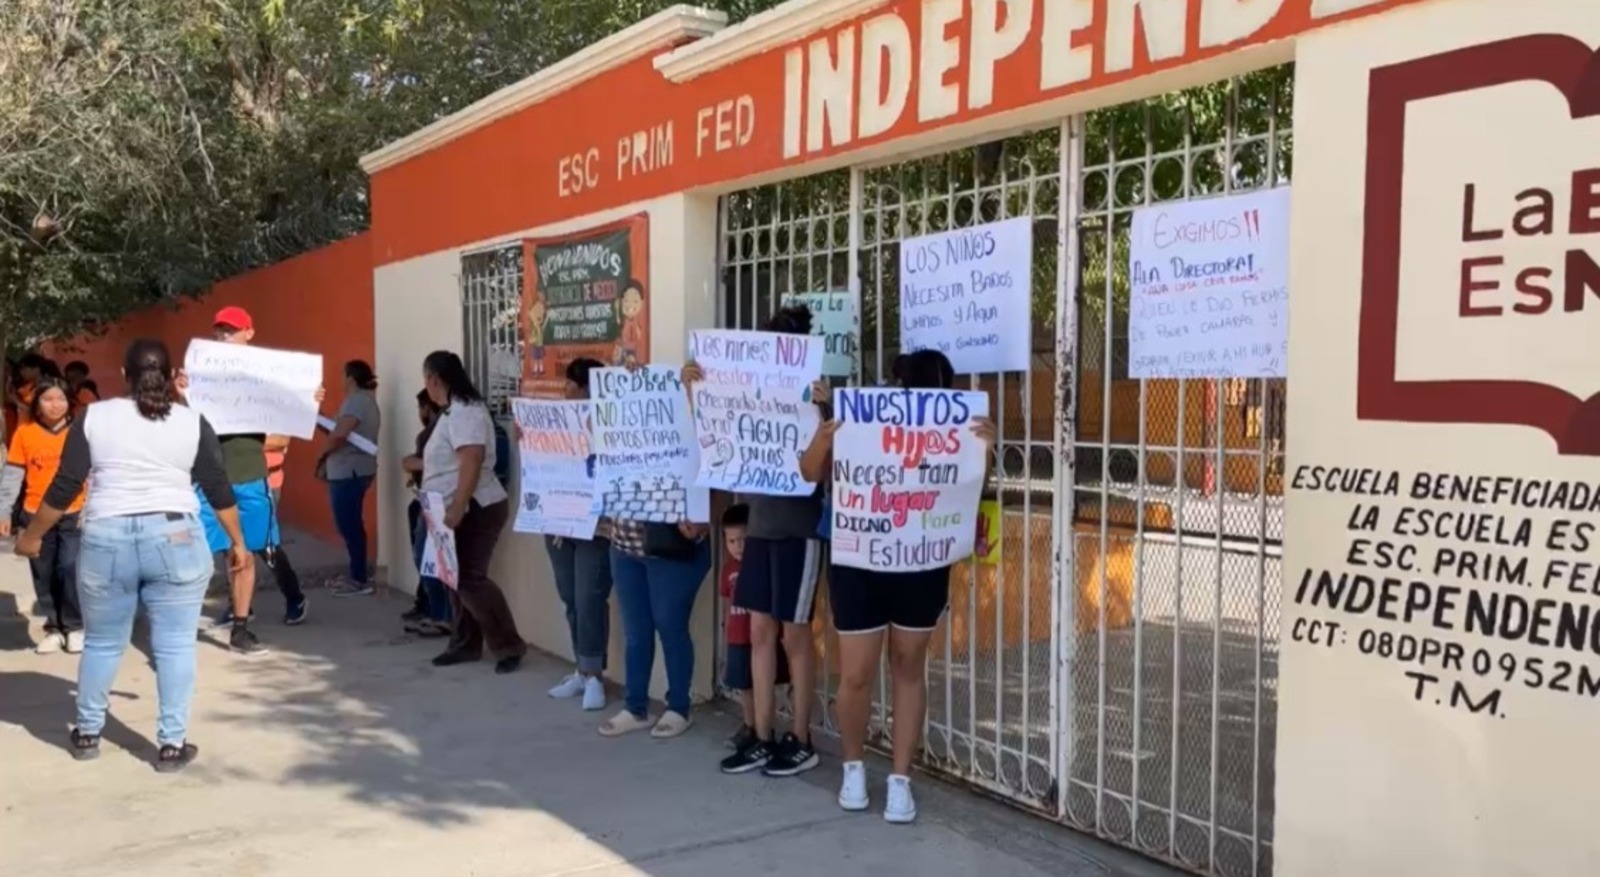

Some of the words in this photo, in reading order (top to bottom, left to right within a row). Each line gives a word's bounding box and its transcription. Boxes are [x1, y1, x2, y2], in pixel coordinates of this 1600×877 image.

[783, 0, 1388, 158] INDEPEN
[559, 147, 599, 197] ESC
[617, 120, 673, 181] PRIM
[697, 94, 755, 157] FED
[905, 241, 940, 274] LOS
[596, 401, 617, 427] NO
[738, 413, 799, 452] AGUA
[1291, 465, 1400, 496] ESCUELA
[835, 511, 892, 534] DIGNO
[870, 484, 941, 528] lugar
[1347, 503, 1380, 531] LA
[1393, 507, 1532, 548] ESCUELA
[1546, 520, 1596, 552] ES
[1346, 538, 1422, 573] ESC.
[1433, 548, 1533, 588] PRIM.
[1292, 617, 1347, 647] CCT:
[1404, 670, 1506, 719] T.M.
